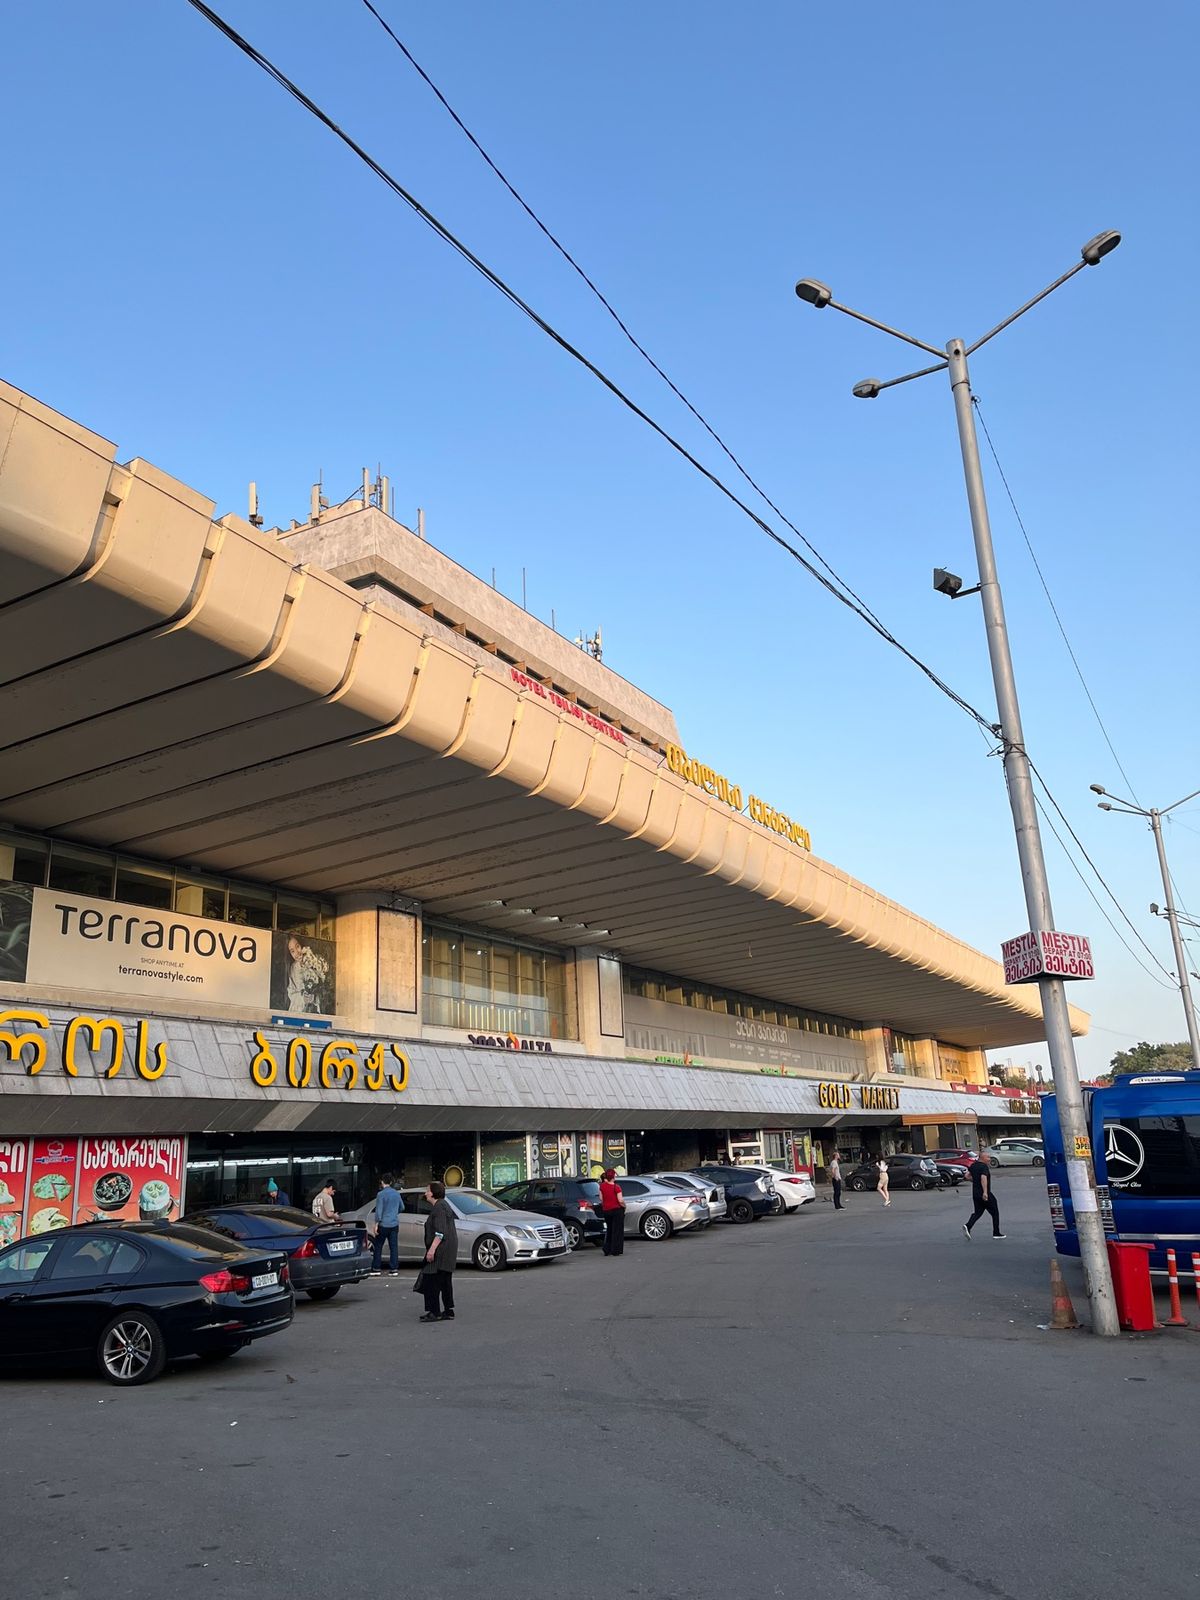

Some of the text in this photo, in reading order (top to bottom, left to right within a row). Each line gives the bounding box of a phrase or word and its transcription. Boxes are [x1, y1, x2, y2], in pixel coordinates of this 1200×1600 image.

[511, 668, 628, 746] HOTEL TBILISI CENTRAL
[665, 743, 743, 811] თბილისი
[55, 904, 257, 963] Terranova
[1001, 931, 1038, 958] MESTIA
[1041, 931, 1090, 954] MESTIA
[140, 957, 155, 965] SHOP
[155, 959, 178, 967] ANYTIME
[1004, 955, 1020, 967] DEPART
[1044, 947, 1067, 956] DEPART
[1077, 951, 1092, 960] 07:00
[1046, 954, 1094, 977] მესტია
[118, 965, 204, 983] terranovastyle.com
[1005, 957, 1042, 983] მესტია
[521, 1040, 553, 1052] ALTA
[250, 1030, 409, 1092] ბირჟა
[818, 1082, 900, 1110] GOLD MARKET
[83, 1138, 181, 1180] სამზარეულო
